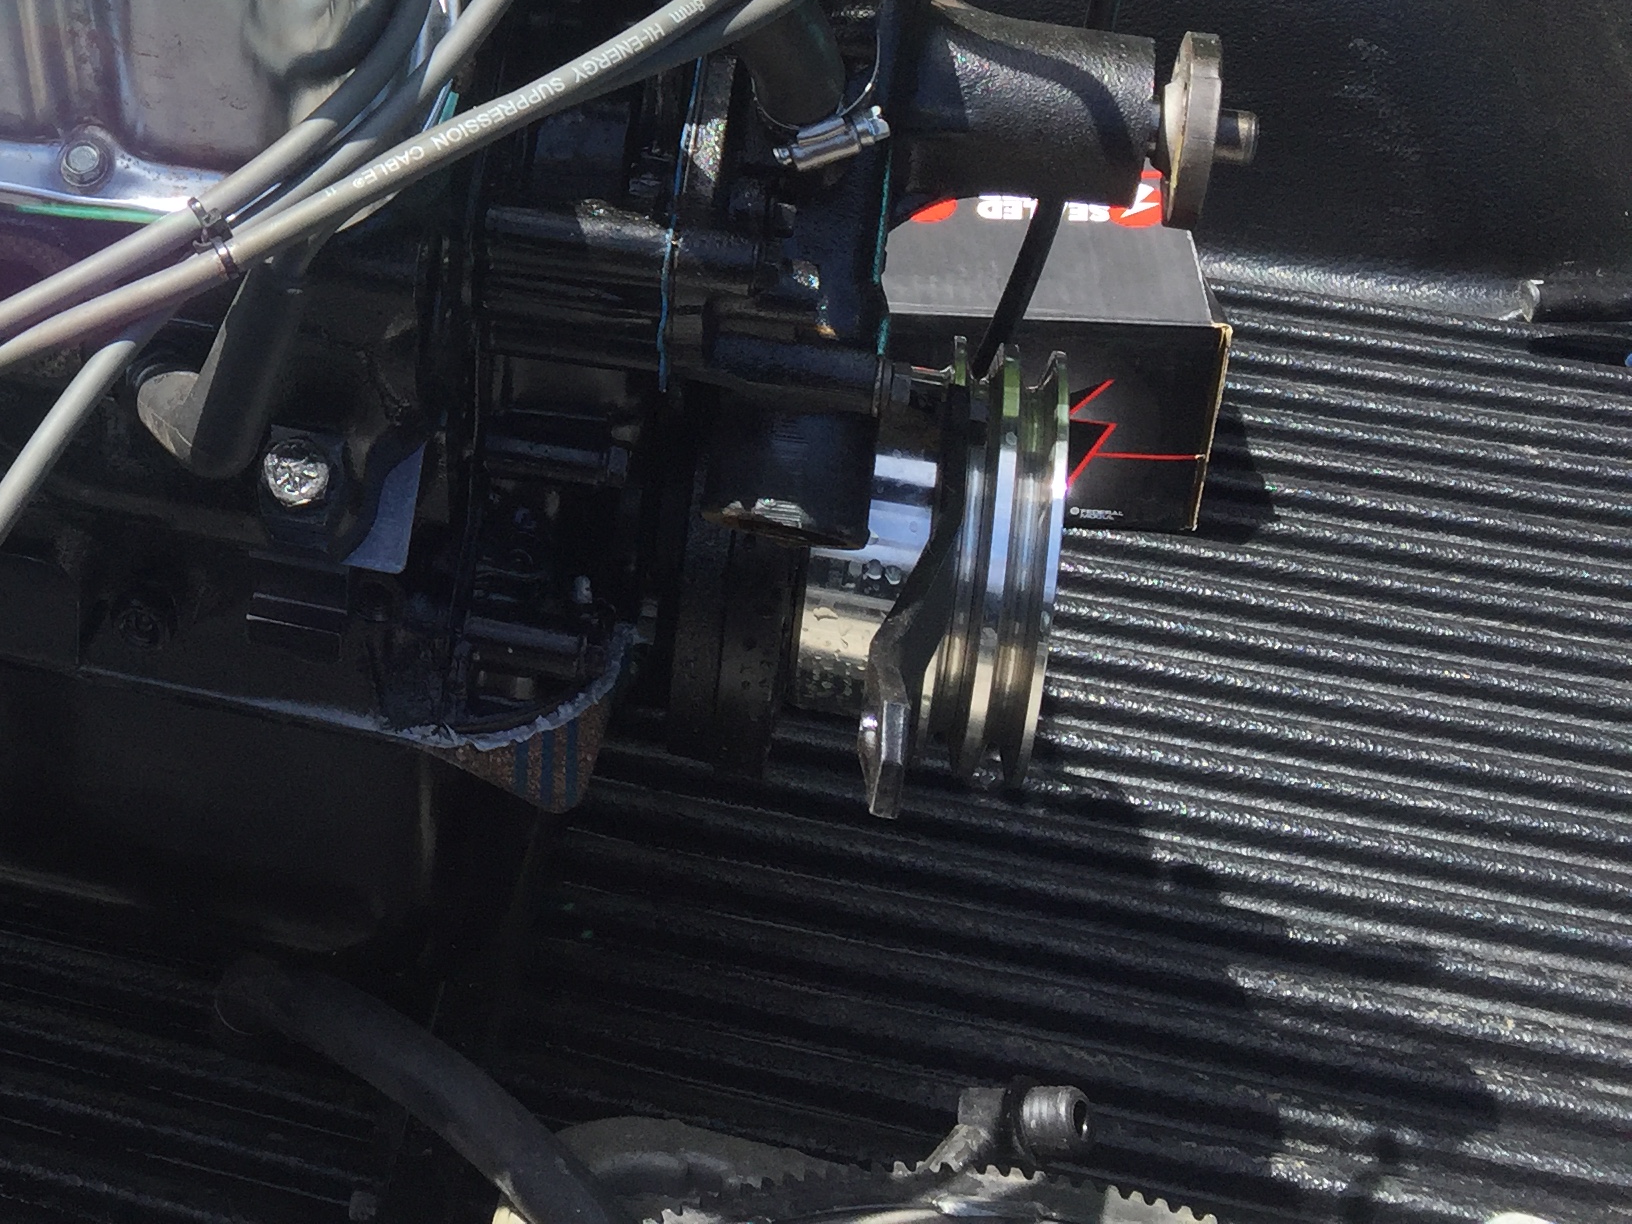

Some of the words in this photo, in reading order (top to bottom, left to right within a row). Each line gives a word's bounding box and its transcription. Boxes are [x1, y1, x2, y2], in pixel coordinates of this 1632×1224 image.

[573, 22, 666, 83] HI-ENERGY
[431, 77, 566, 151] SUPPRESSION
[977, 199, 1111, 222] SELED
